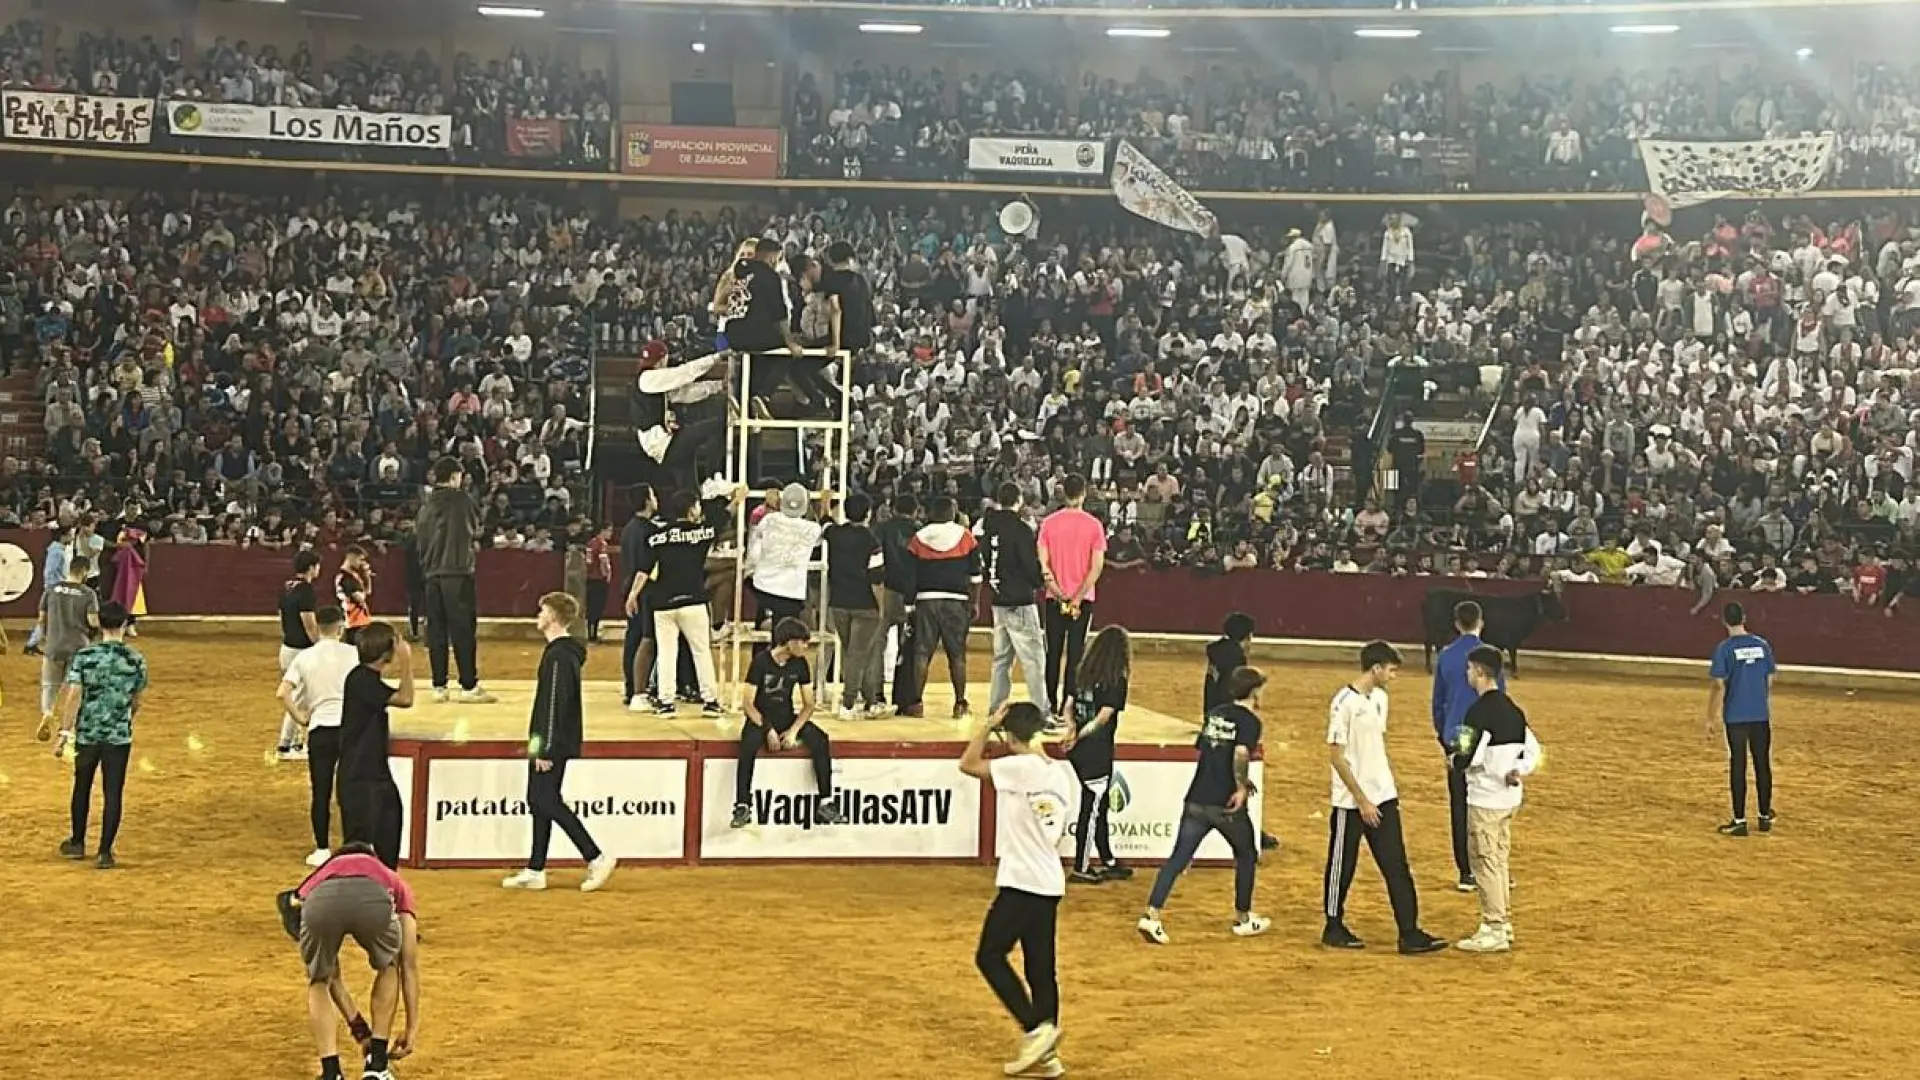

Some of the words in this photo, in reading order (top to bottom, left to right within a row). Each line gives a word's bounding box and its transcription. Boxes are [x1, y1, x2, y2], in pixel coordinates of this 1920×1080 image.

[269, 110, 323, 138] Los
[332, 114, 442, 144] Maños
[1014, 143, 1038, 155] PEÑA
[679, 153, 692, 164] DE
[695, 154, 748, 165] ZARAGOZA
